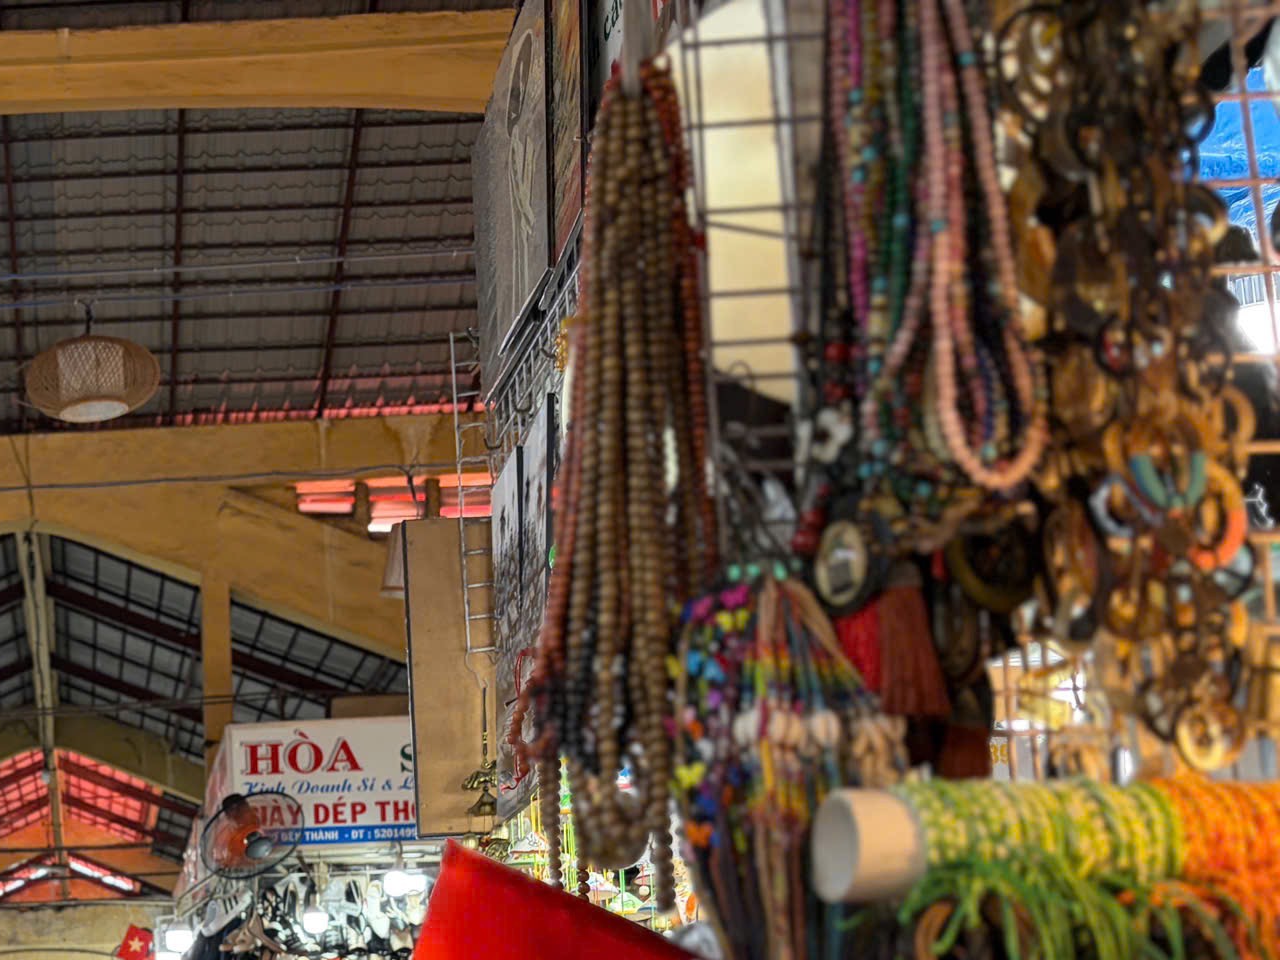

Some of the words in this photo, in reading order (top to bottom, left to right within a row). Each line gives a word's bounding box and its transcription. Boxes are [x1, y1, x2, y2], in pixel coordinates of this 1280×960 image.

[241, 728, 363, 776] HÒA
[253, 799, 302, 828] IÀY
[313, 796, 367, 825] DÉP
[305, 829, 338, 841] THÀNH
